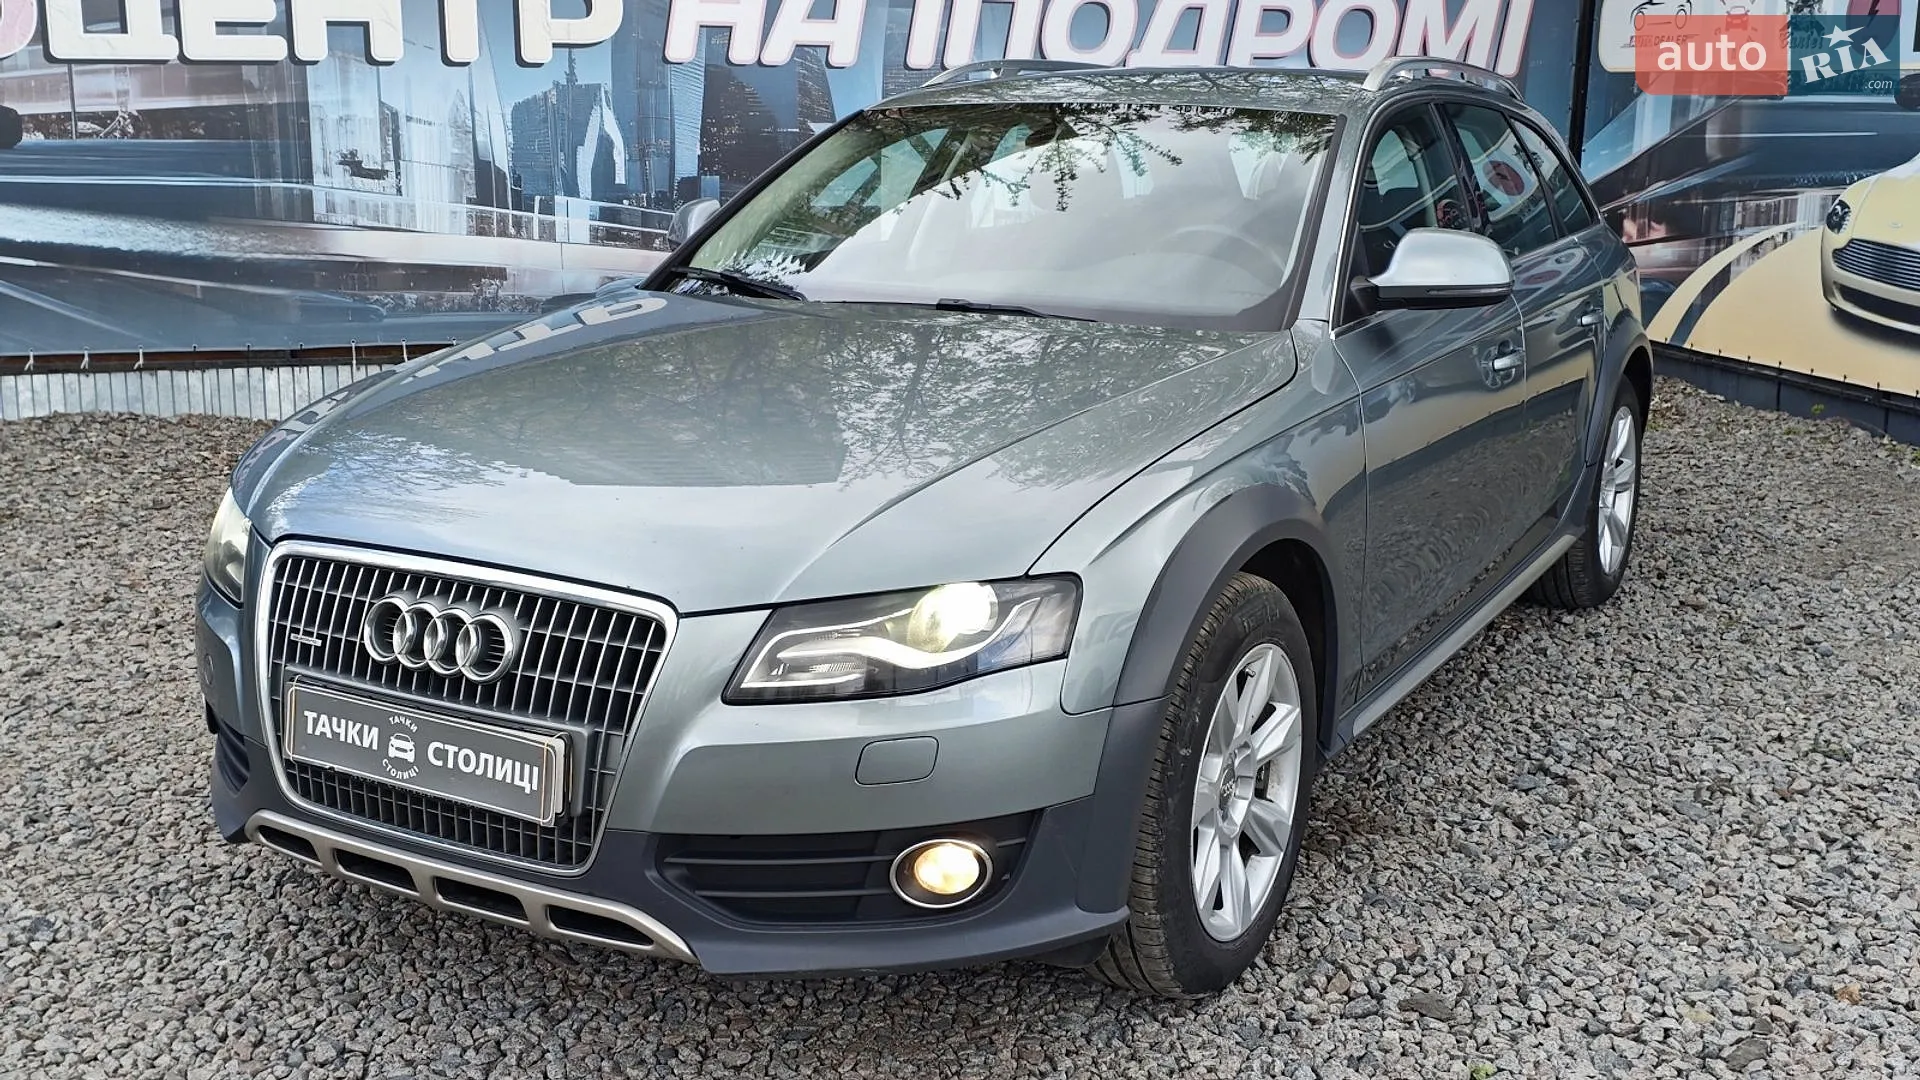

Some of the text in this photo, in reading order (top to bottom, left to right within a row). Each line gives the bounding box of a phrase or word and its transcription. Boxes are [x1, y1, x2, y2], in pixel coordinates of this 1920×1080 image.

[0, 0, 624, 64] ЦЕНР
[663, 0, 868, 67] НА
[303, 710, 379, 751] ТАЧКИ
[389, 715, 418, 733] ТАЧКИ
[382, 758, 419, 780] СТОЛИЦІ
[427, 741, 539, 794] СТОЛИЦІ
